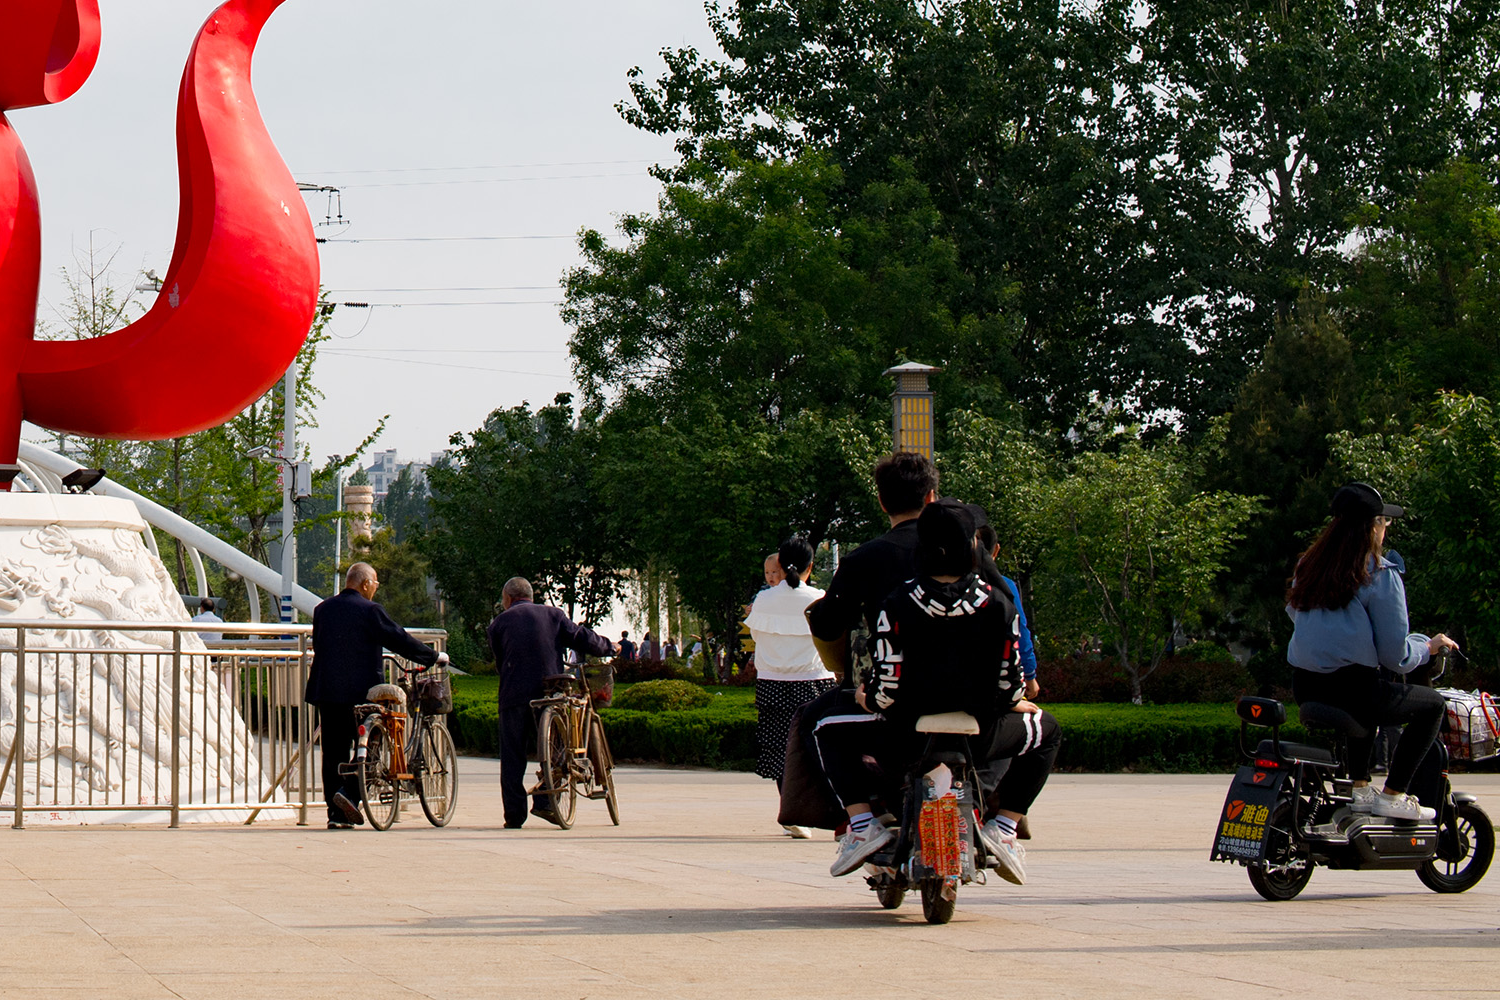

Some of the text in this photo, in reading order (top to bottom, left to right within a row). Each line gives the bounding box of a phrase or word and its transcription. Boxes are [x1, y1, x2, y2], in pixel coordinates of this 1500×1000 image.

[1240, 804, 1269, 825] 雅迪
[1221, 821, 1265, 841] 更高端的电动车
